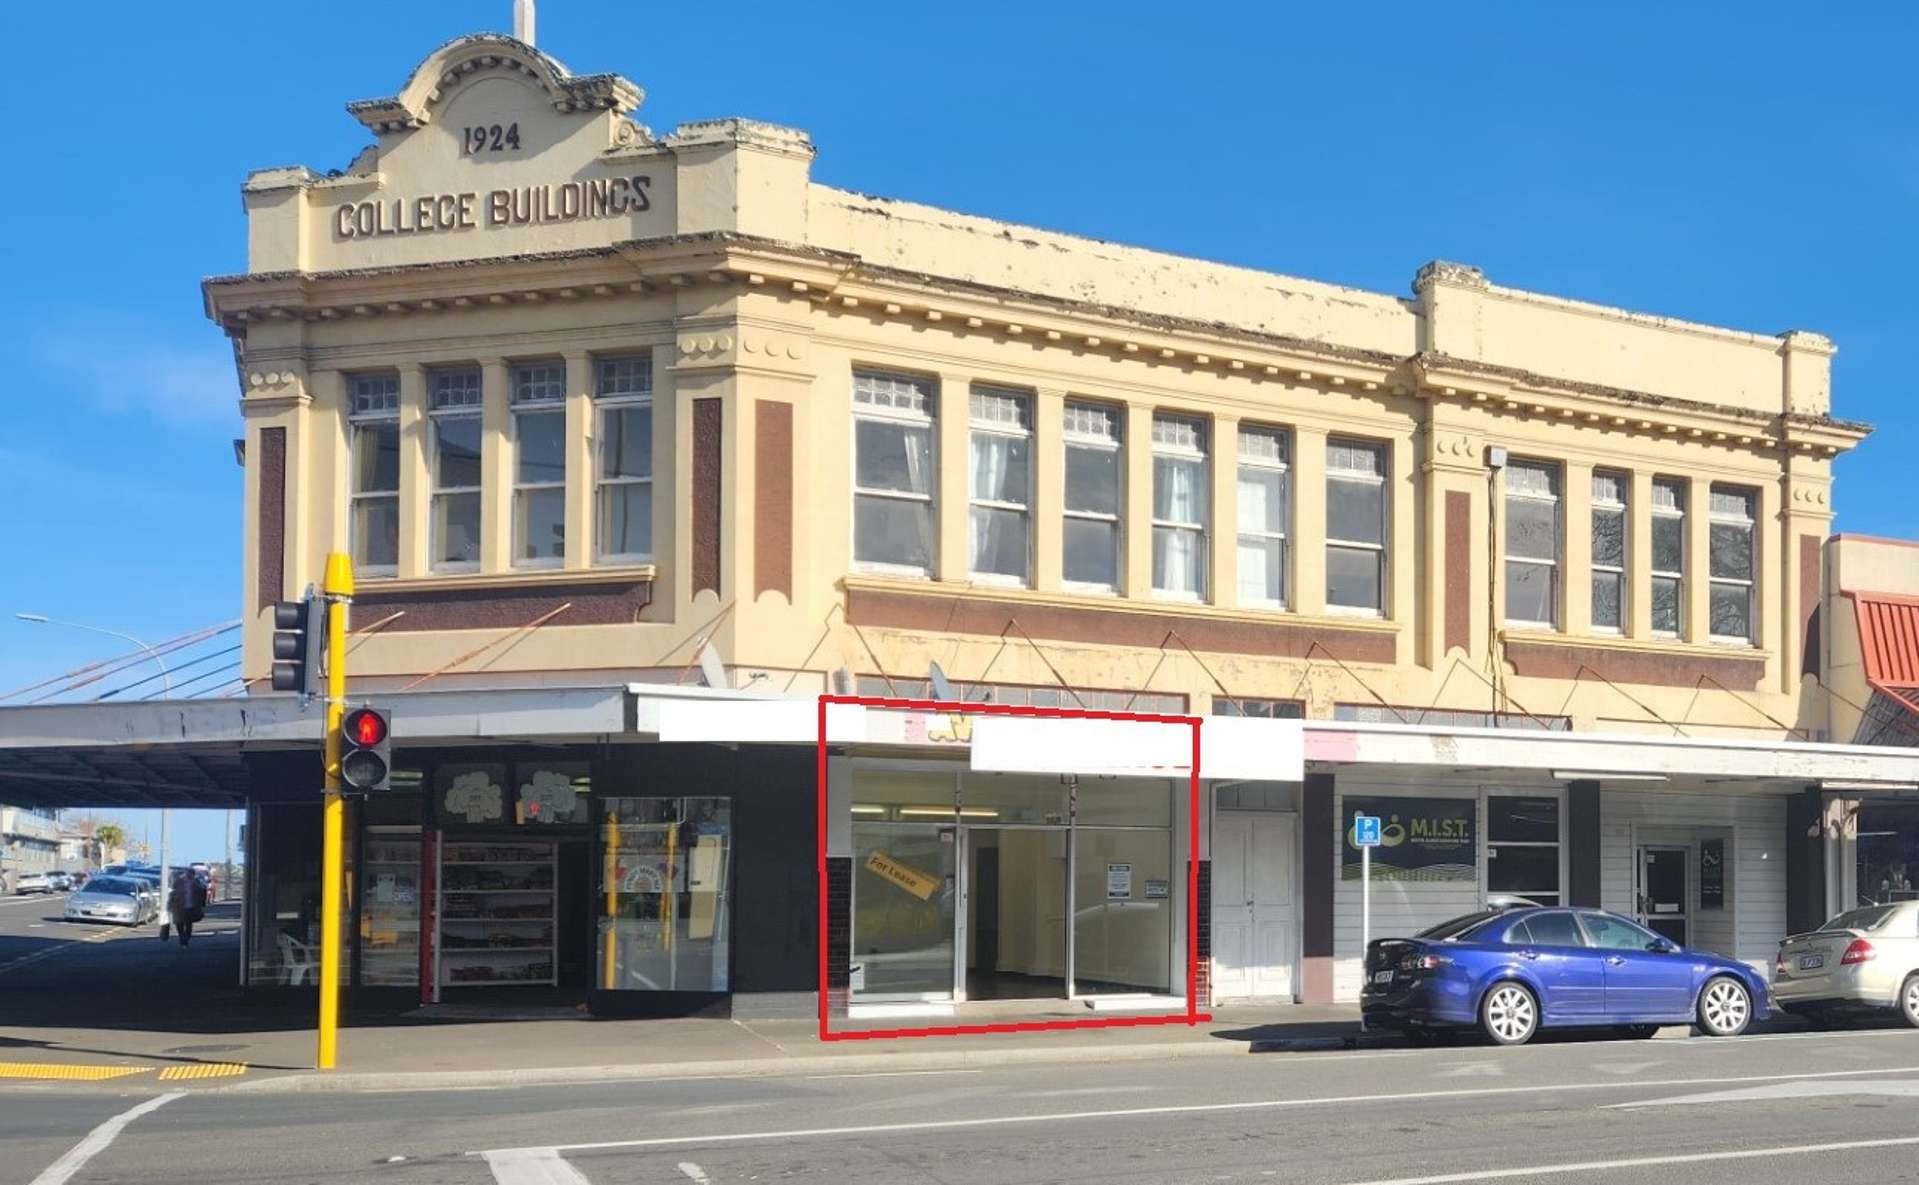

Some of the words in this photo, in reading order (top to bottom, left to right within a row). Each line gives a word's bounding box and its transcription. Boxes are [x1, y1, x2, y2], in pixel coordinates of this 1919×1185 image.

[463, 122, 520, 155] 1924
[337, 192, 476, 239] COLLEGE
[489, 175, 651, 226] BUILDINGS
[1364, 819, 1373, 830] P
[1410, 818, 1469, 837] M.I.S.T.
[870, 857, 888, 872] For
[888, 867, 917, 886] Lease
